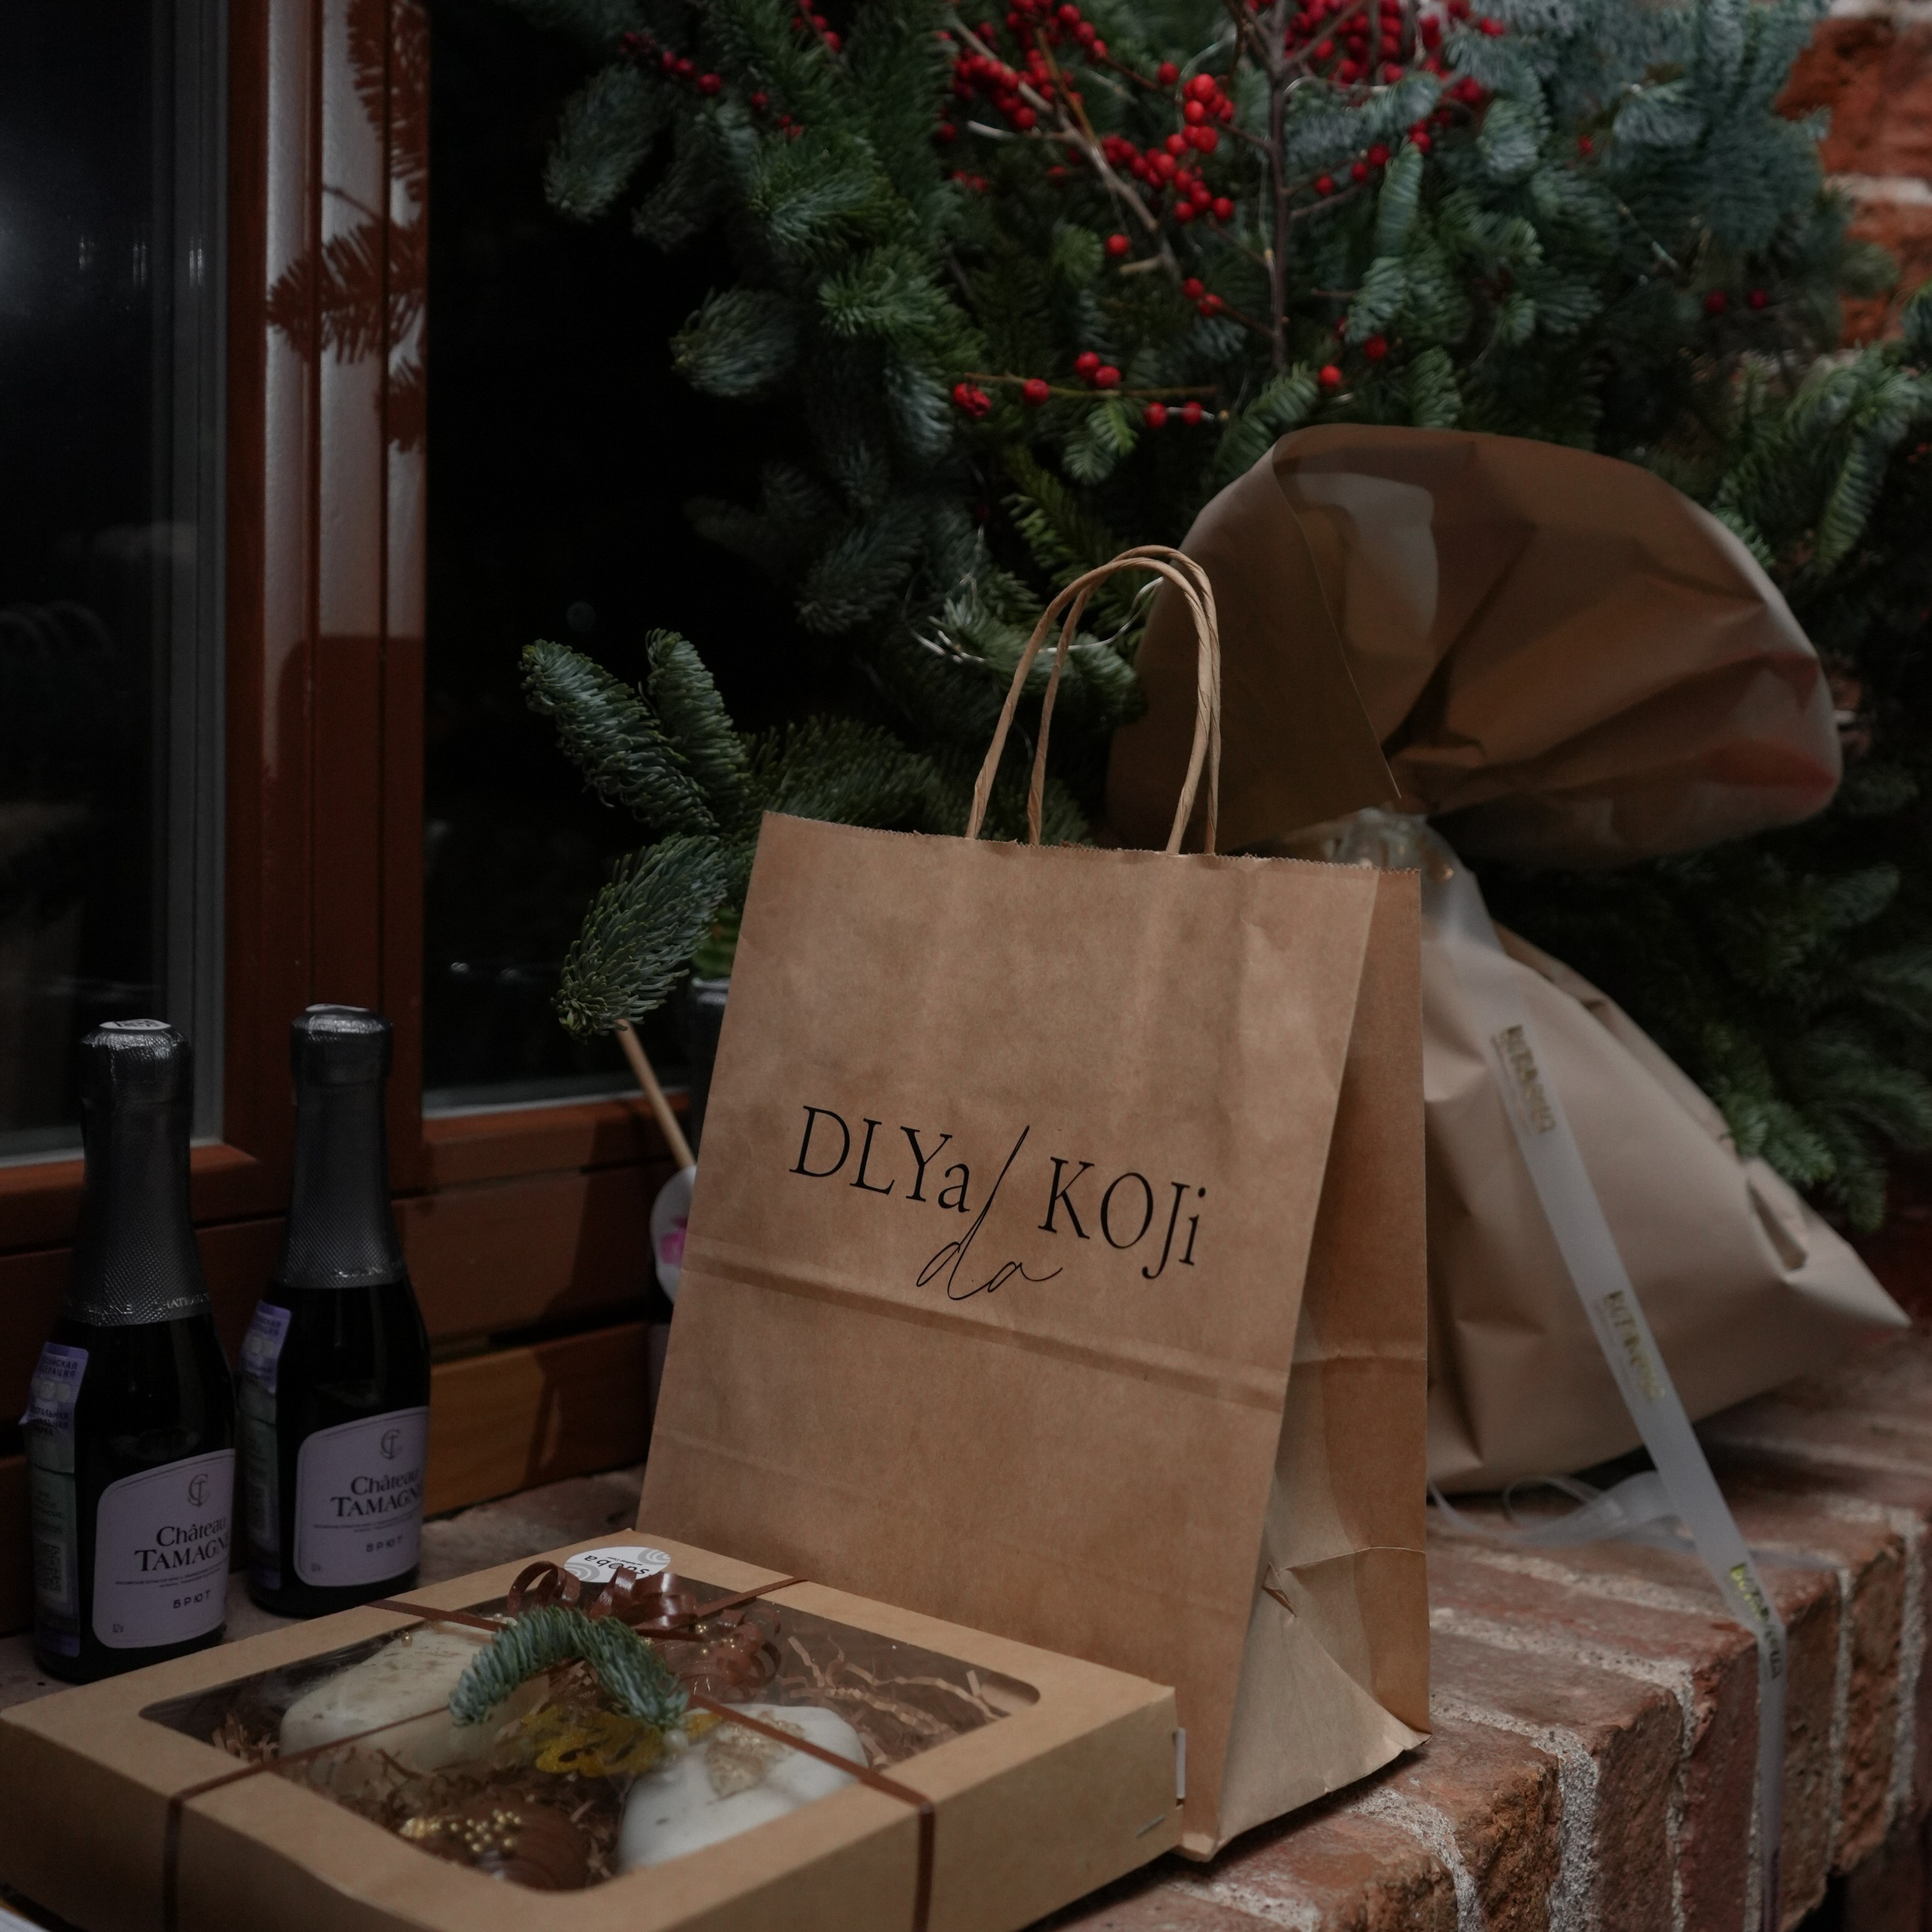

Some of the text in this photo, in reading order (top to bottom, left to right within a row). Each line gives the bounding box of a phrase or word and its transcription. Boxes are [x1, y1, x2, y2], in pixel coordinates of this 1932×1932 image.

[789, 1106, 1206, 1279] DLYa KOJi
[156, 1515, 226, 1547] Château
[173, 1589, 211, 1609] БРЮТ
